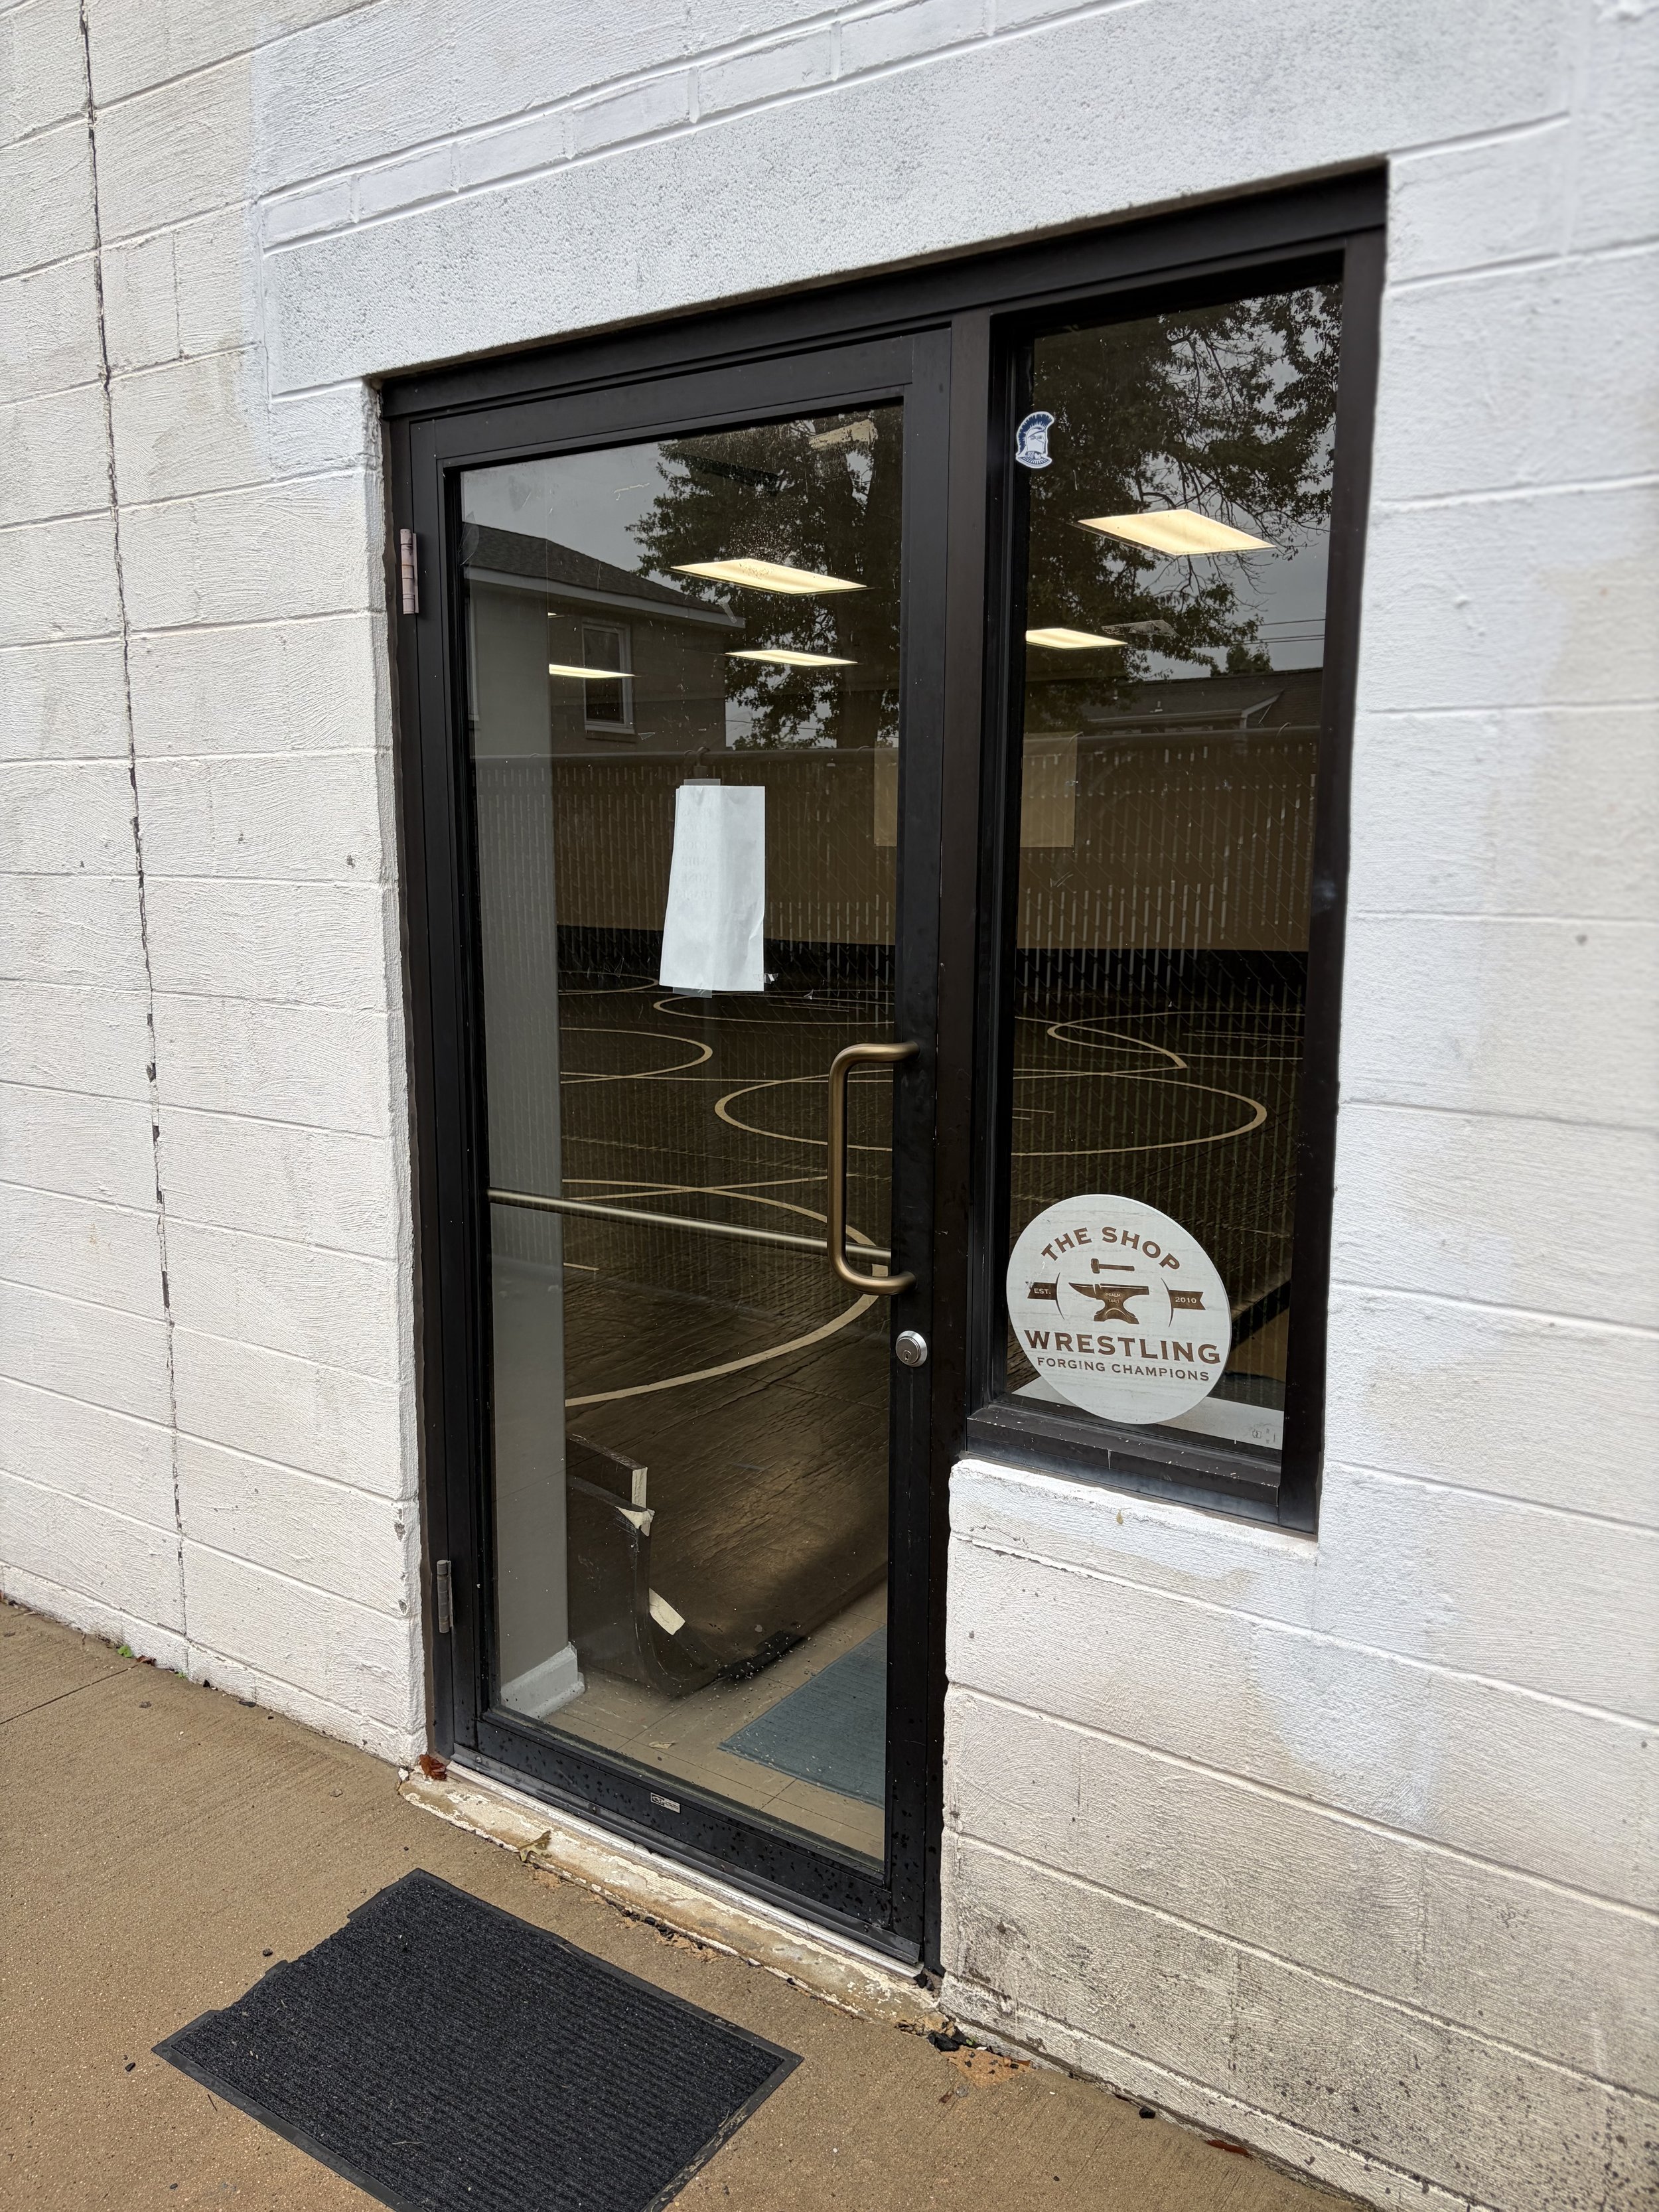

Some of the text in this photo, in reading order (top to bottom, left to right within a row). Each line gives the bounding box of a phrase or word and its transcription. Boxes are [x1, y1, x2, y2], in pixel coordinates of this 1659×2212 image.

[1041, 1226, 1181, 1270] THE SHOP
[1023, 1329, 1221, 1364] WRESTLING
[1037, 1357, 1210, 1381] FORGING CHAMPIONS
